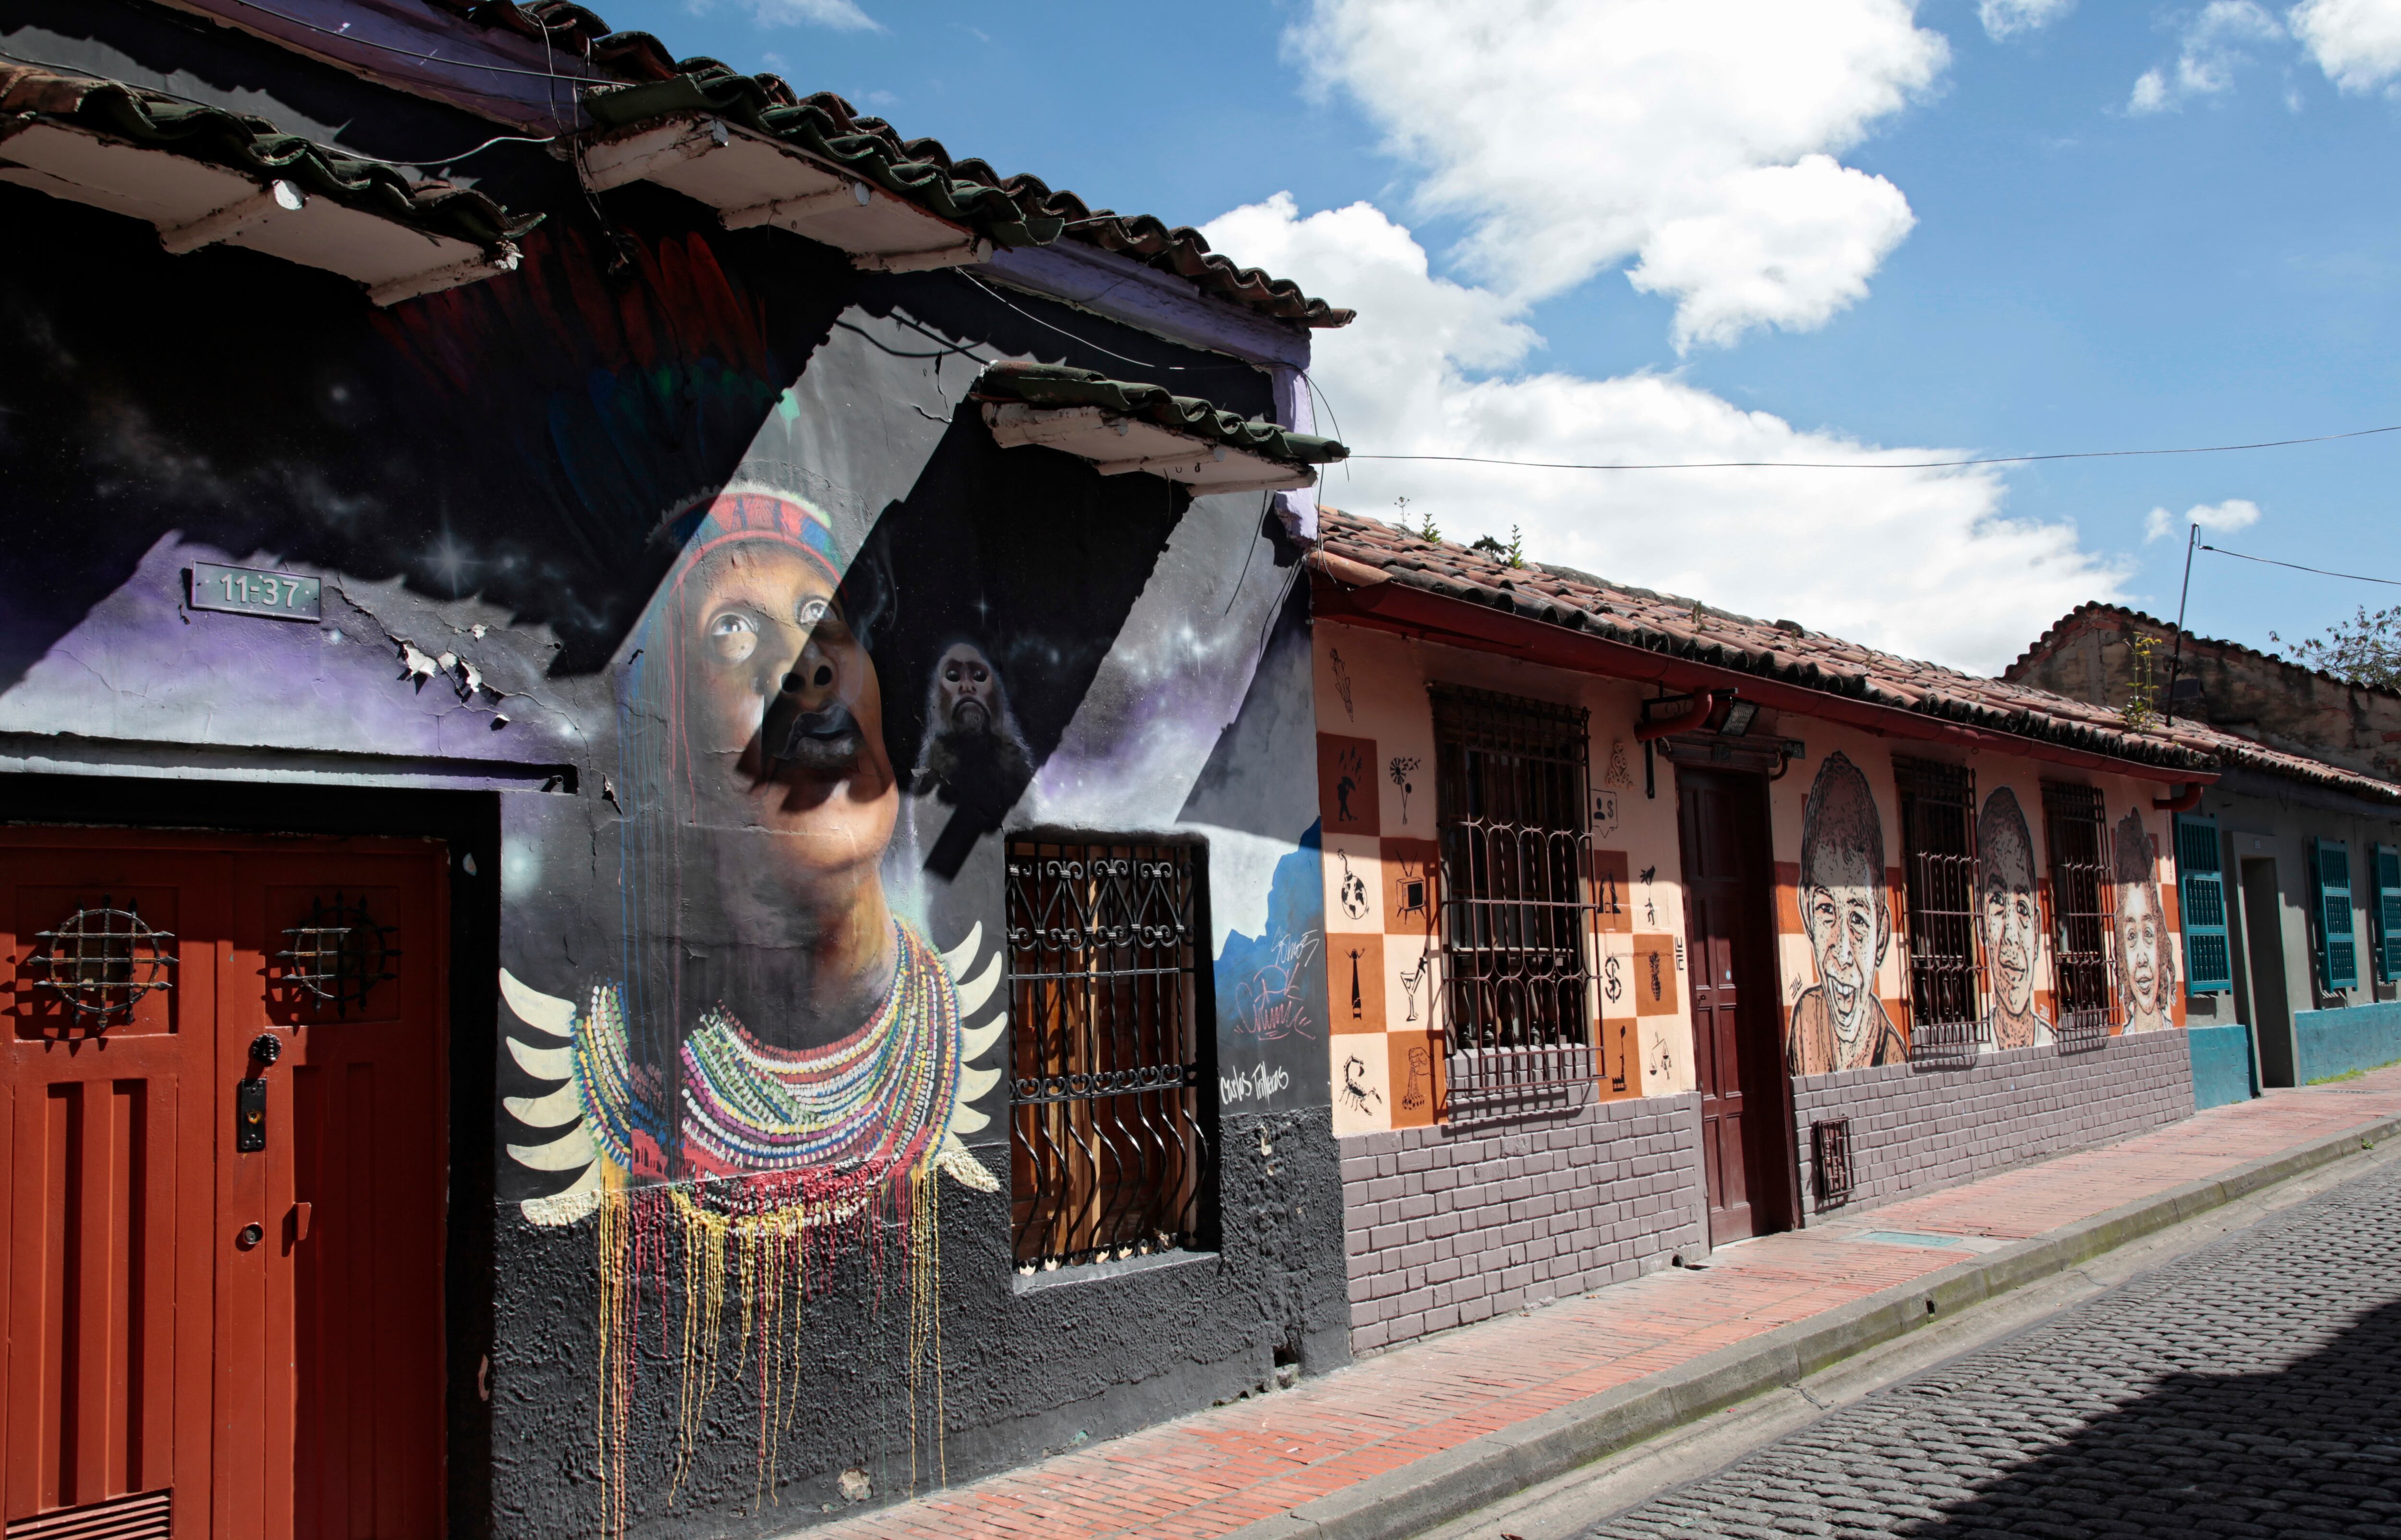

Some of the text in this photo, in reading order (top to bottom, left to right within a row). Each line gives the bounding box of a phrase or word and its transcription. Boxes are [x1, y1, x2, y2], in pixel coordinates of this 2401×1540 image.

[220, 574, 300, 608] 11-37
[1786, 743, 1801, 755] 11-45
[1220, 1065, 1252, 1105] Carlos
